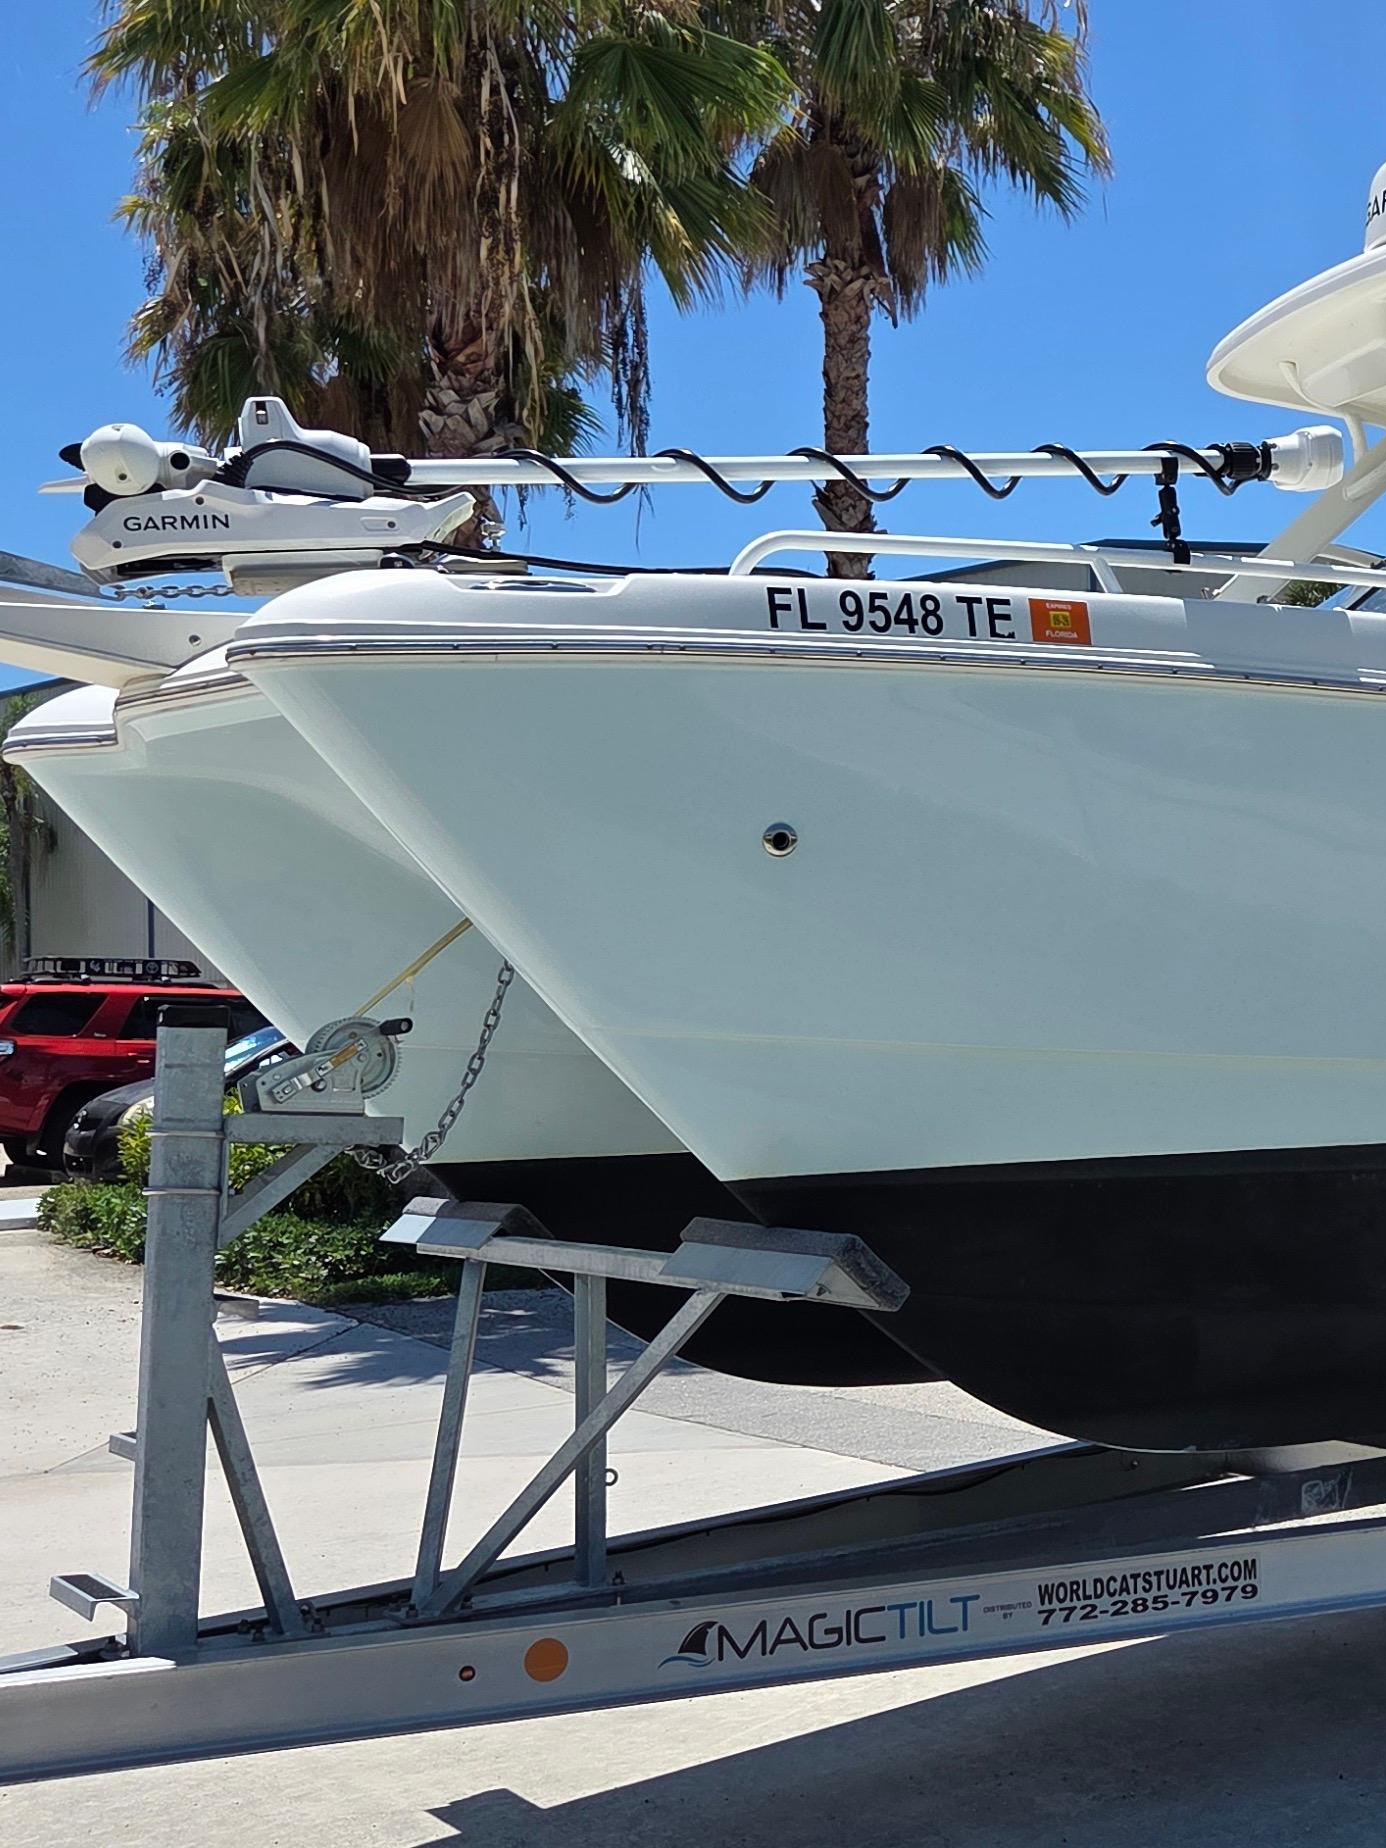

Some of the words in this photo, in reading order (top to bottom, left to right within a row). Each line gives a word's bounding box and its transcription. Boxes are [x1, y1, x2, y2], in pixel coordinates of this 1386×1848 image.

[123, 513, 230, 532] GARMIN
[766, 586, 827, 630] FL
[839, 589, 944, 636] 9548
[955, 595, 1016, 639] TE
[1045, 630, 1078, 638] FLORIDA
[1038, 1558, 1258, 1606] WORLDCATSTUART.COM
[983, 1601, 1032, 1613] DISTRIBUTED
[1002, 1612, 1013, 1620] BY
[1037, 1583, 1259, 1626] 772-285-7979
[717, 1594, 981, 1662] MAGICTILT
